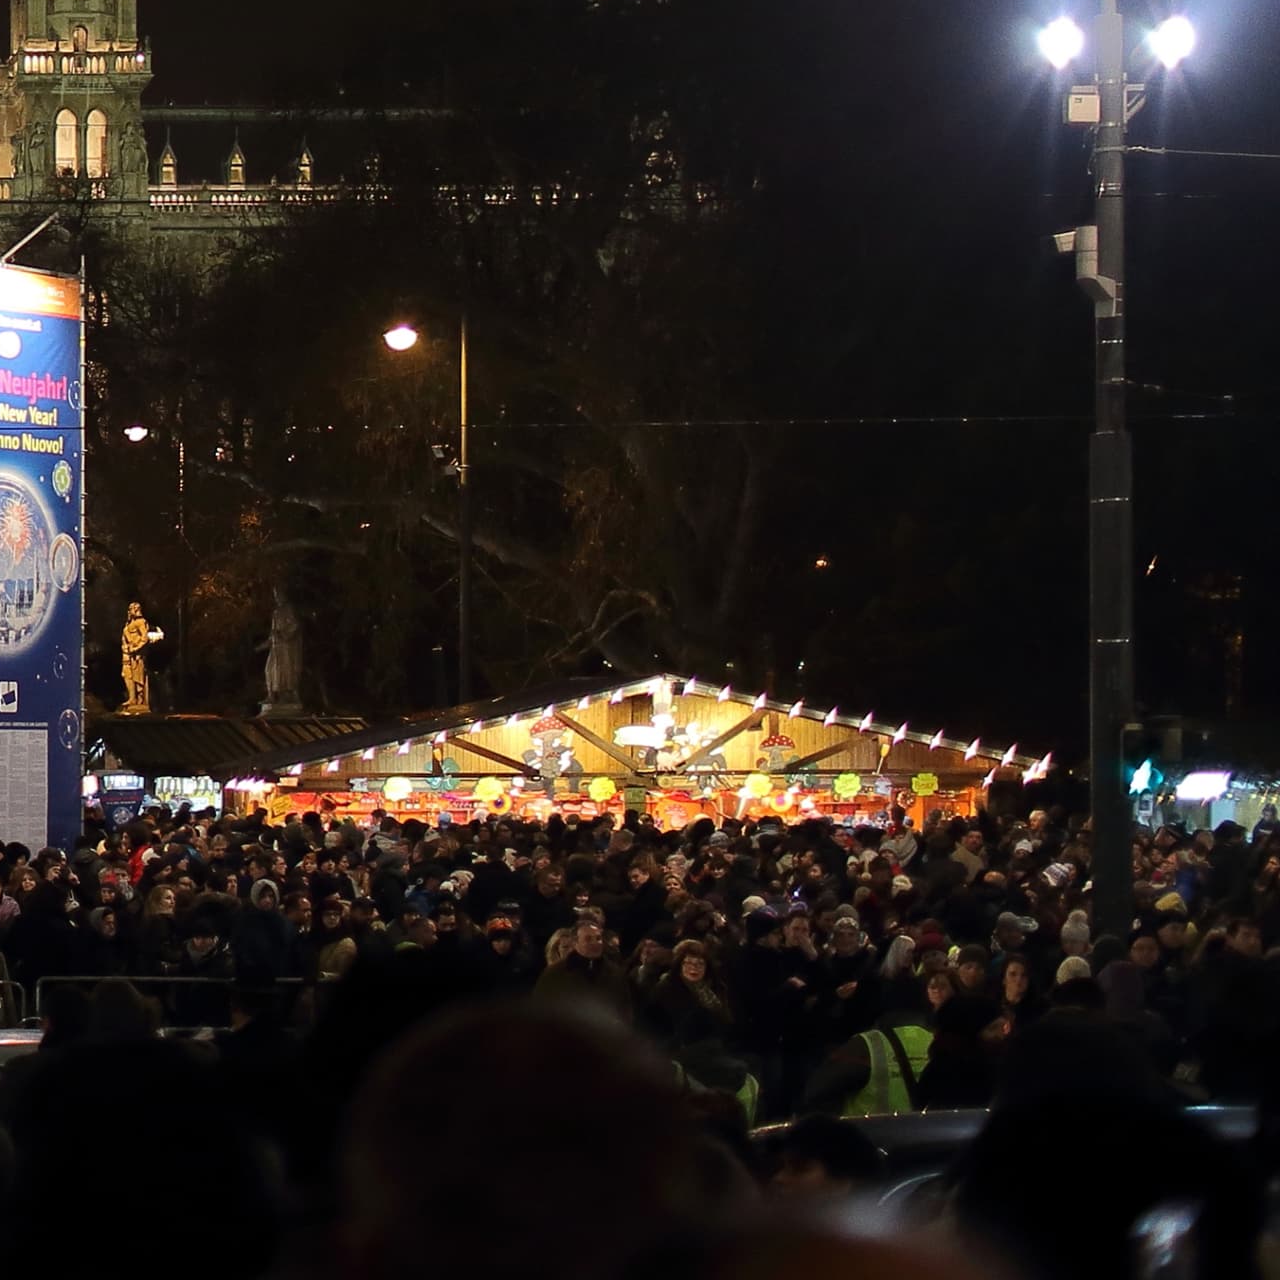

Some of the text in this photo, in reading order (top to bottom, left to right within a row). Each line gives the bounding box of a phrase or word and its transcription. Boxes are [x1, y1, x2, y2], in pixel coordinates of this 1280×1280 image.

[0, 402, 28, 423] New
[29, 406, 58, 426] Year!
[22, 433, 64, 455] Nuovo!
